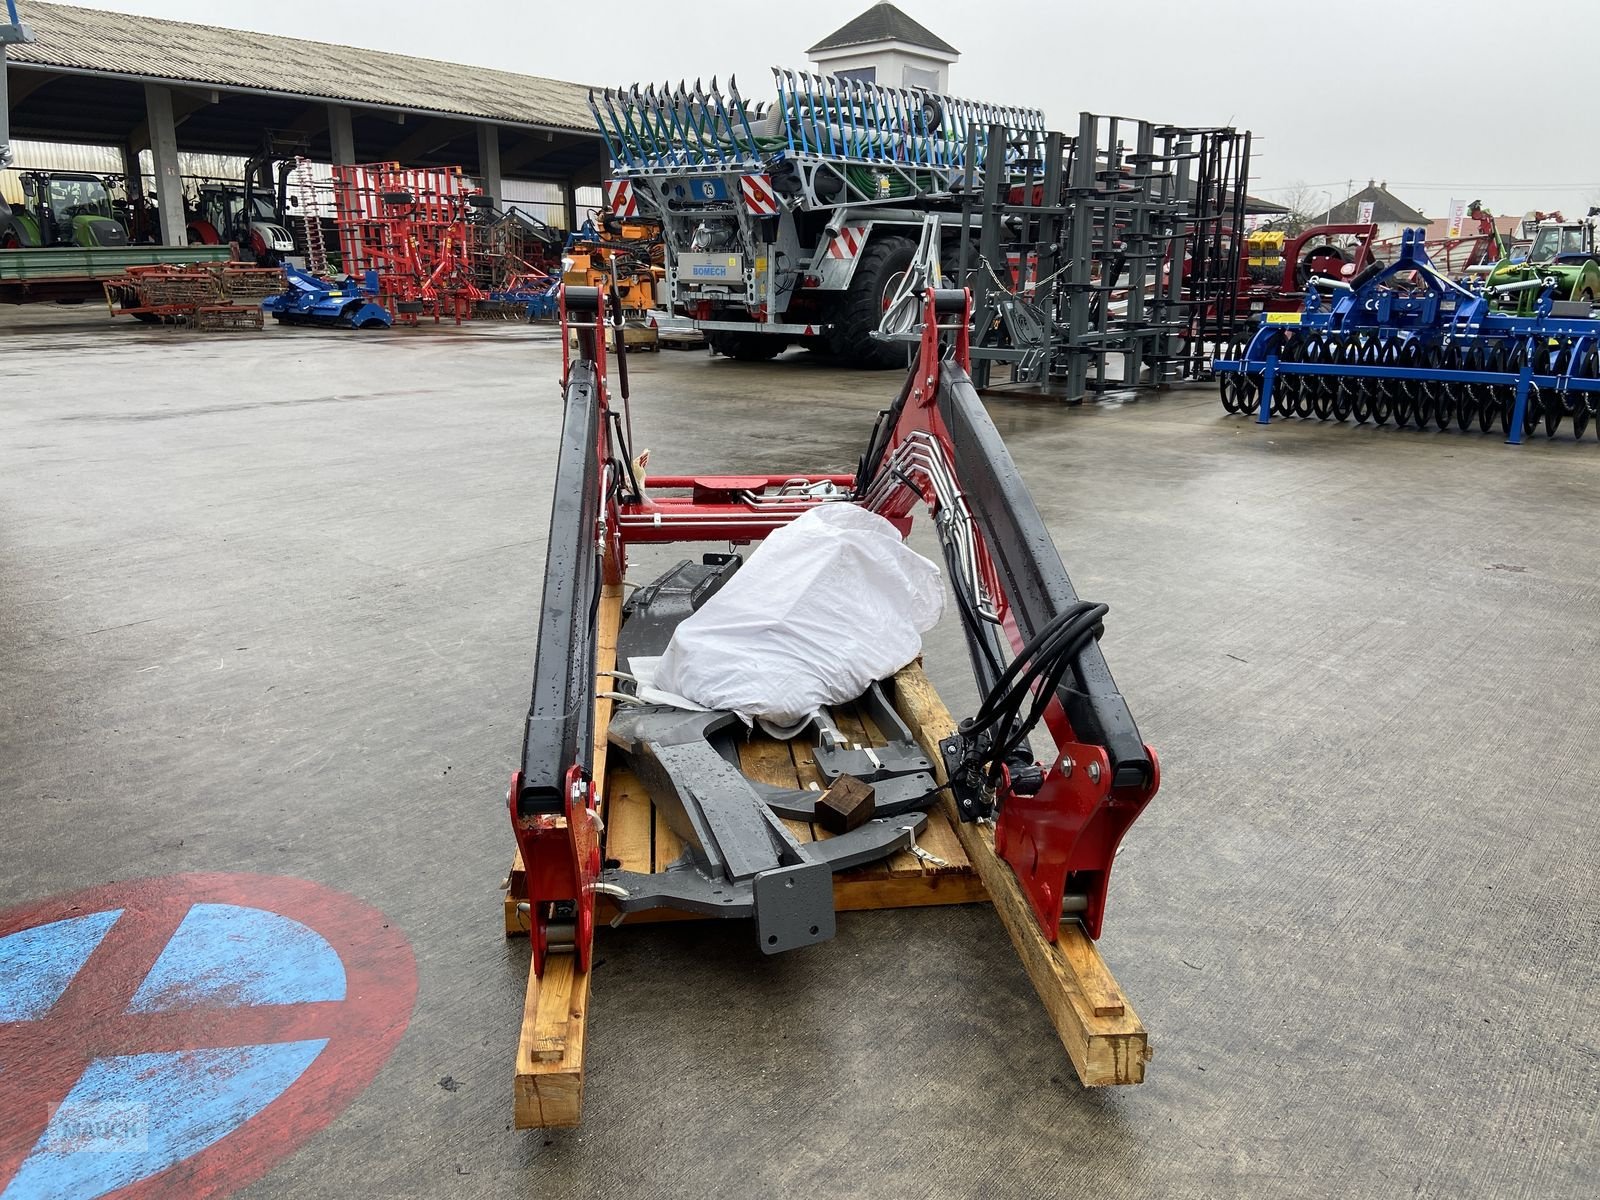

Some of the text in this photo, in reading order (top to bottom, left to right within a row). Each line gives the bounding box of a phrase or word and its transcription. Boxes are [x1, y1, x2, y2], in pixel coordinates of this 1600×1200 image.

[704, 184, 713, 195] 25
[1453, 206, 1463, 235] MAUCH
[693, 268, 726, 276] BOMECH
